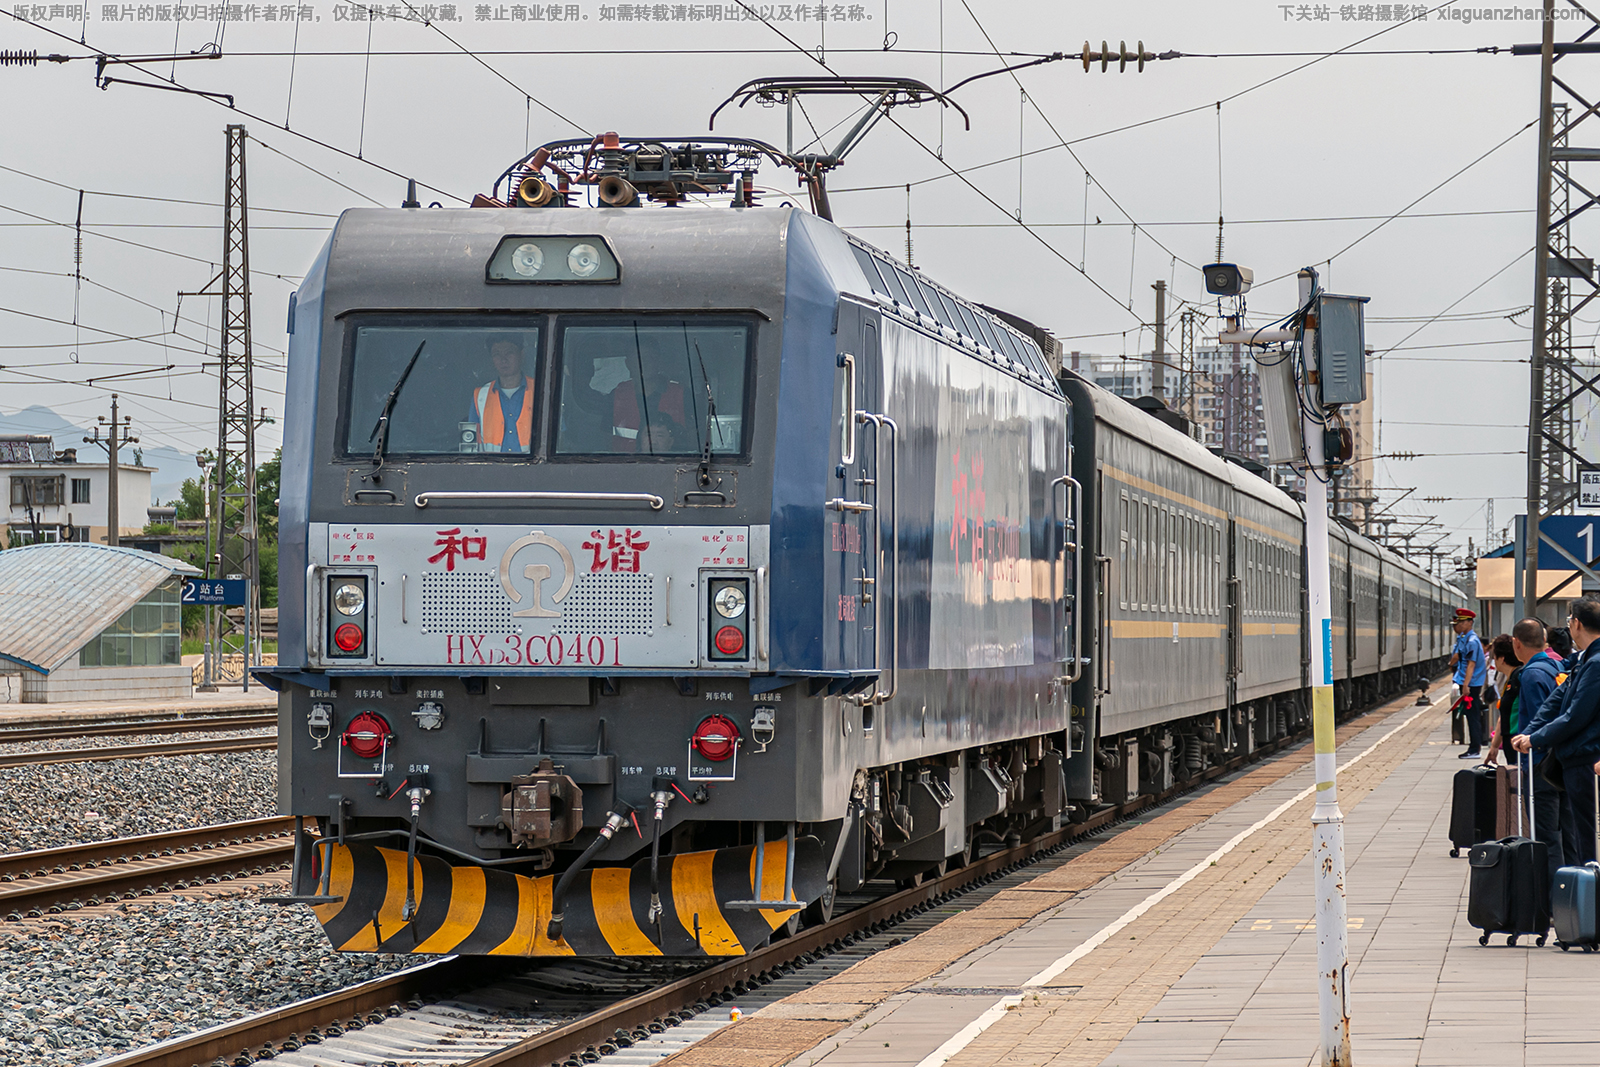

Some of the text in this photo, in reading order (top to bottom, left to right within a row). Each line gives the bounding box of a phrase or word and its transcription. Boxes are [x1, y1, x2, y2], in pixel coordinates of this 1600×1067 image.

[427, 527, 651, 573] 和 谐
[1577, 523, 1594, 563] 1
[183, 582, 225, 601] 2 站台
[446, 633, 623, 666] HXD3C0401
